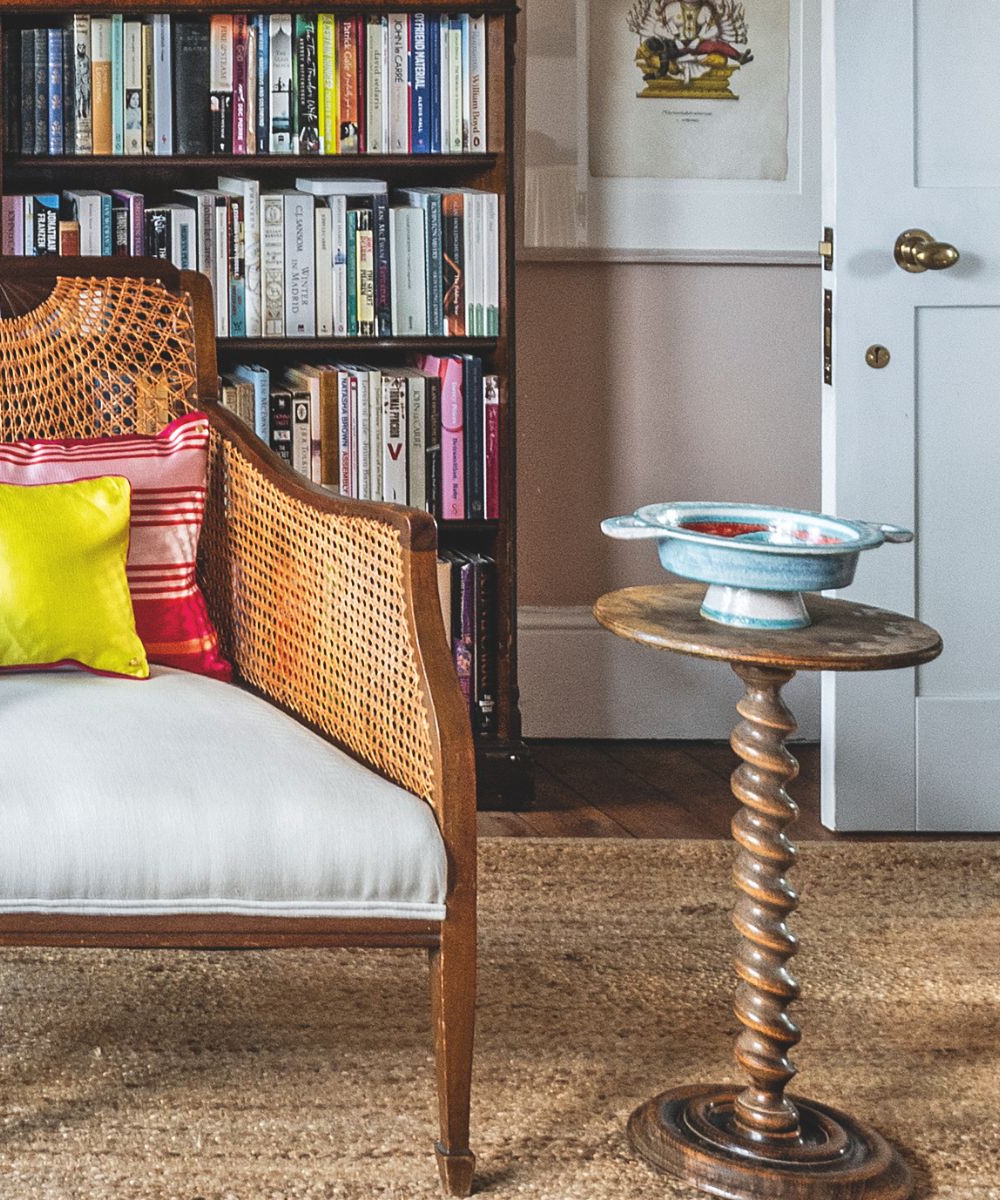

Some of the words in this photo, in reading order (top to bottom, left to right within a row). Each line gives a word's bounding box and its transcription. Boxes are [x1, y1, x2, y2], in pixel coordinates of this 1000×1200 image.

[343, 22, 352, 48] Patrick
[394, 19, 404, 45] JOHN
[414, 13, 425, 49] OYFRIEND
[343, 51, 352, 71] Gale
[373, 49, 381, 75] david
[394, 55, 404, 83] CARRÉ
[414, 51, 425, 90] MATERIAL
[373, 77, 381, 110] sedaris
[472, 74, 480, 109] William
[472, 111, 480, 133] Boyd
[378, 206, 387, 221] IAN
[37, 212, 46, 248] FRANZEN
[47, 210, 57, 251] JONATHAN
[291, 271, 299, 314] MADRID
[301, 266, 309, 305] WINTER
[390, 388, 400, 410] THOMAS
[413, 390, 421, 412] JOHN
[390, 412, 400, 438] PYNCHON
[387, 443, 402, 461] V
